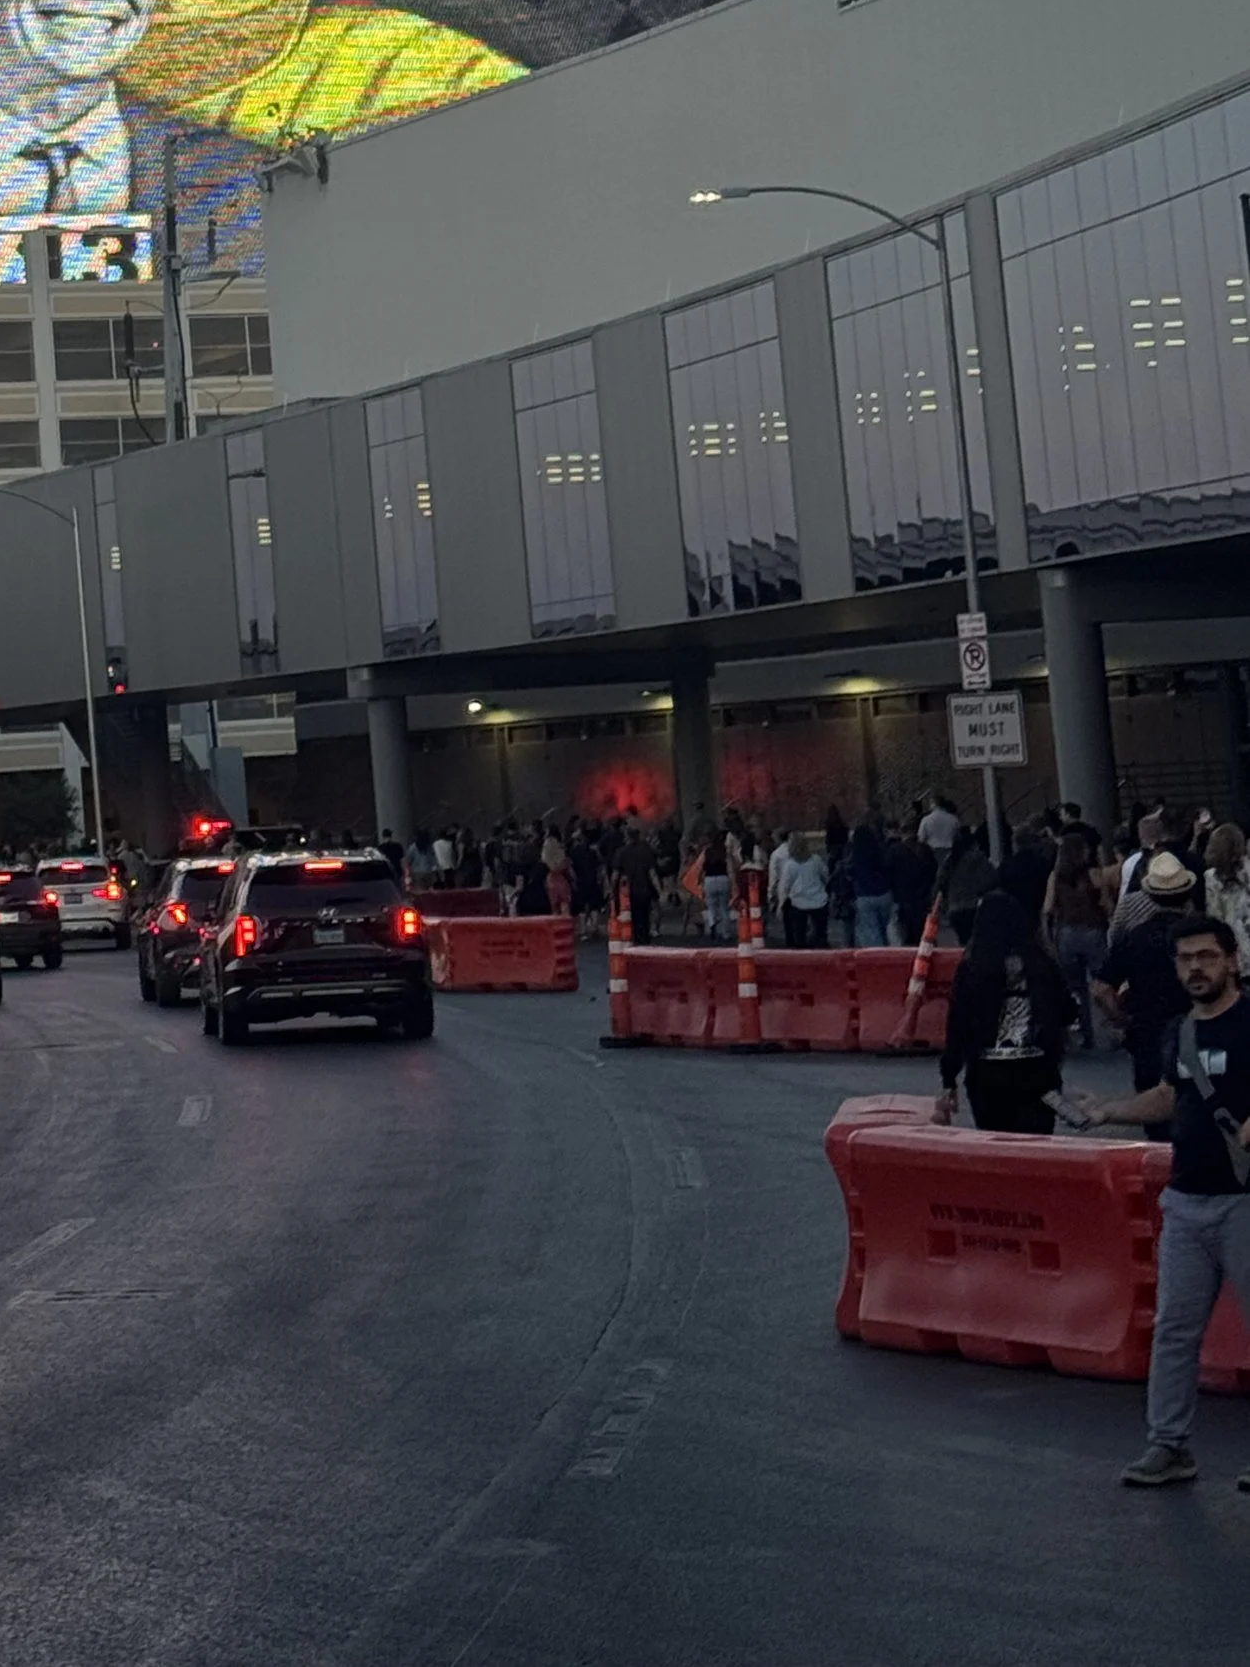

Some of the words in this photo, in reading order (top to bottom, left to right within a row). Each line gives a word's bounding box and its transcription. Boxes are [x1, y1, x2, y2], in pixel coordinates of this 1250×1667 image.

[954, 703, 983, 714] RIGHT
[989, 701, 1016, 714] LANE
[969, 722, 1004, 737] MUST
[958, 745, 985, 758] TURN
[990, 743, 1020, 755] RIGHT
